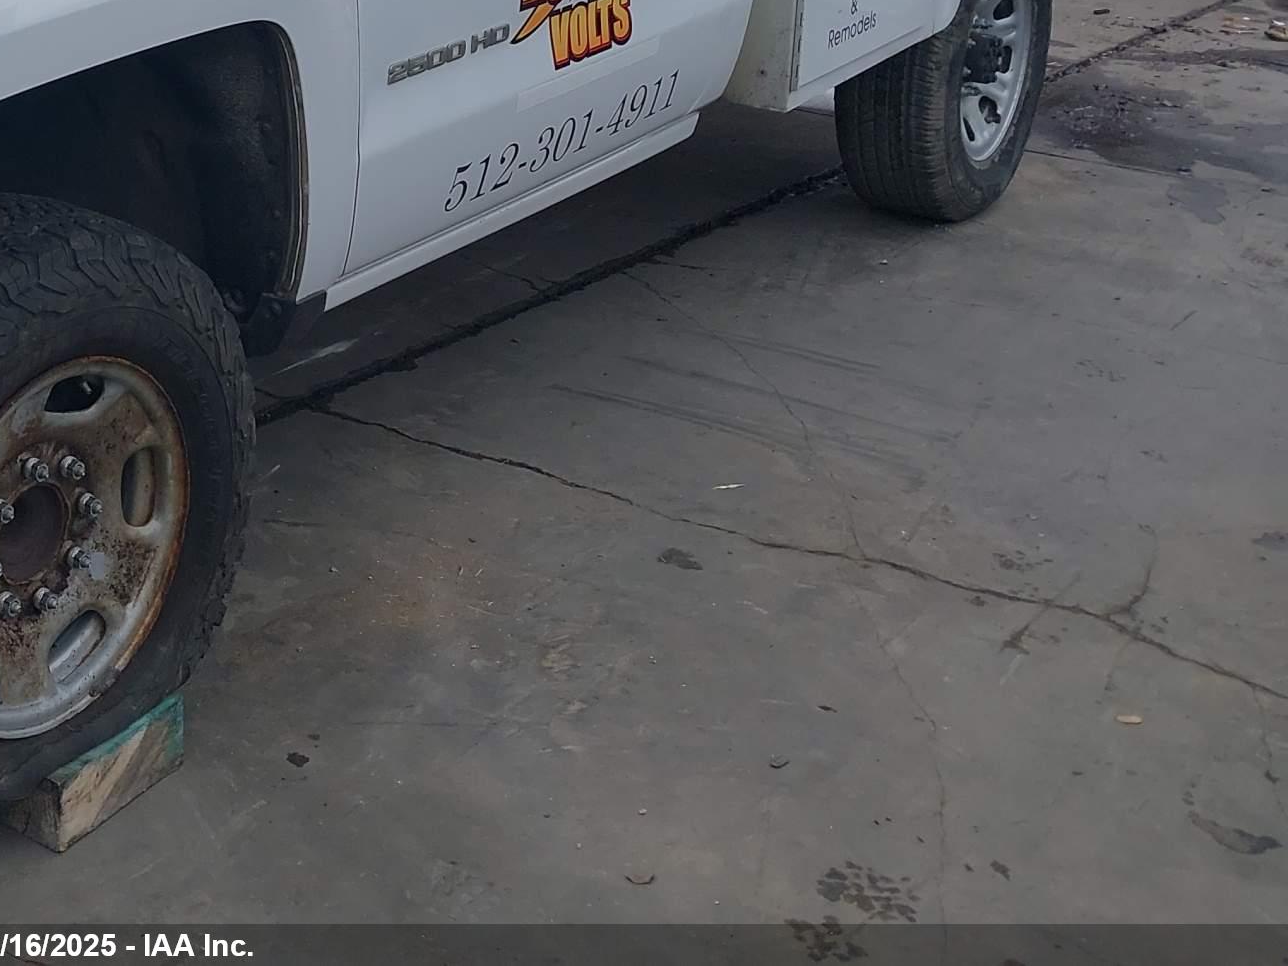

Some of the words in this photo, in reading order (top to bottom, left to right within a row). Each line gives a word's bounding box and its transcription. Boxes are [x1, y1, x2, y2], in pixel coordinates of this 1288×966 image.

[387, 39, 467, 86] 2500
[470, 23, 510, 55] HD
[827, 10, 877, 50] Remodels
[444, 69, 680, 212] 512-301-4911
